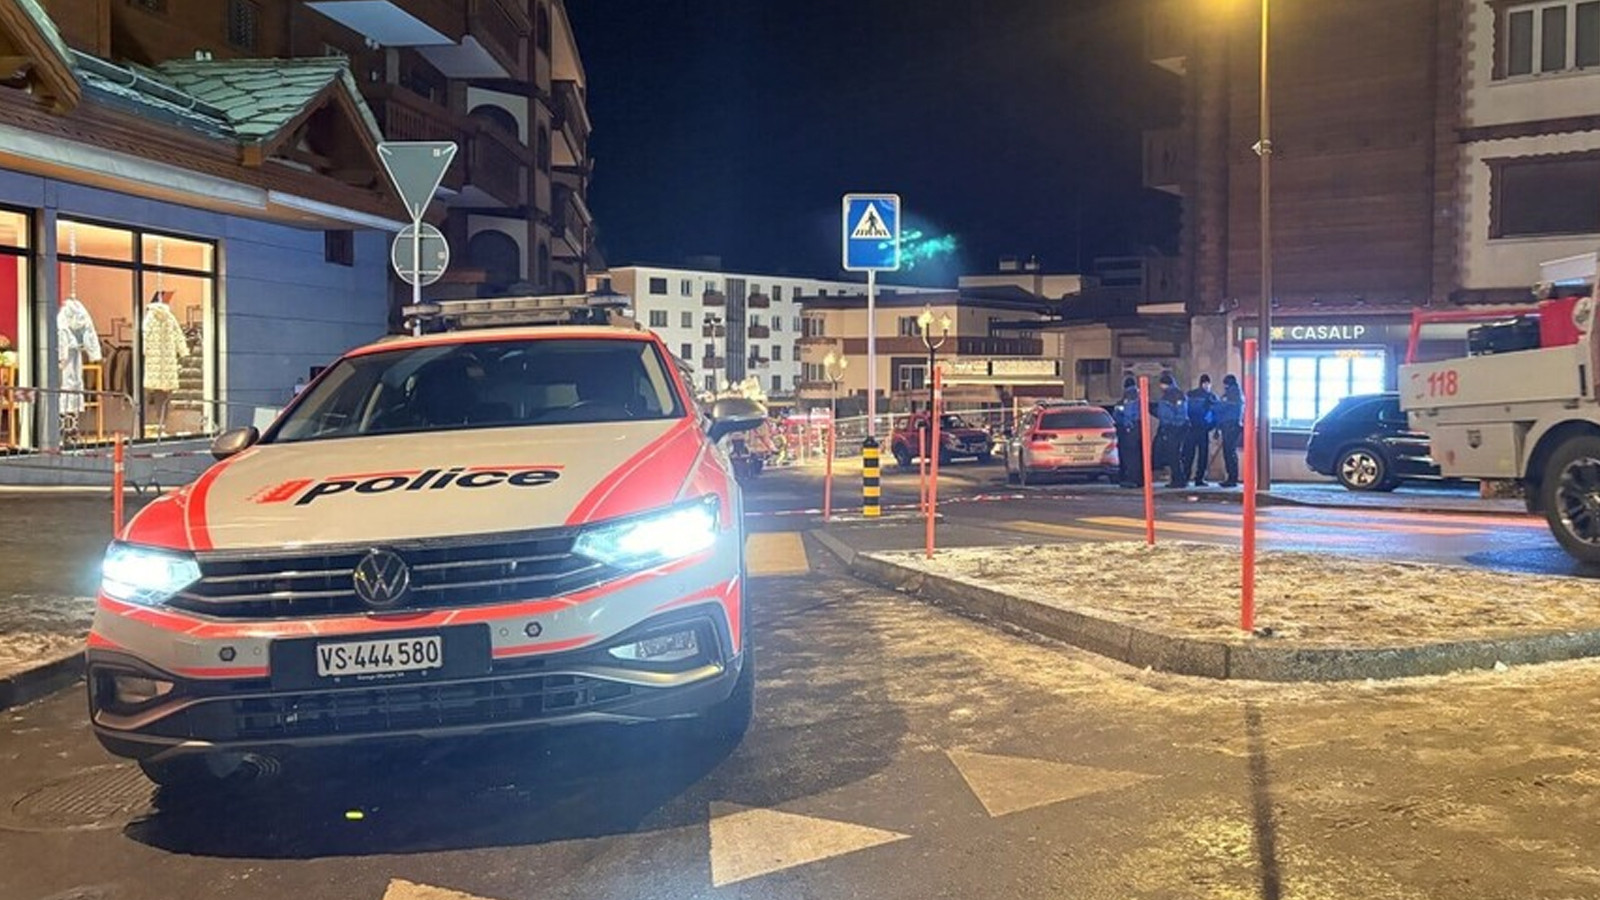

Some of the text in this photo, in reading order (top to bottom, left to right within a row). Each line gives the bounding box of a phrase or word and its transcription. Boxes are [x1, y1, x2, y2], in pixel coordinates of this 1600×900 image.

[1291, 325, 1365, 340] CASALP
[1427, 370, 1458, 397] 118
[294, 468, 561, 506] police
